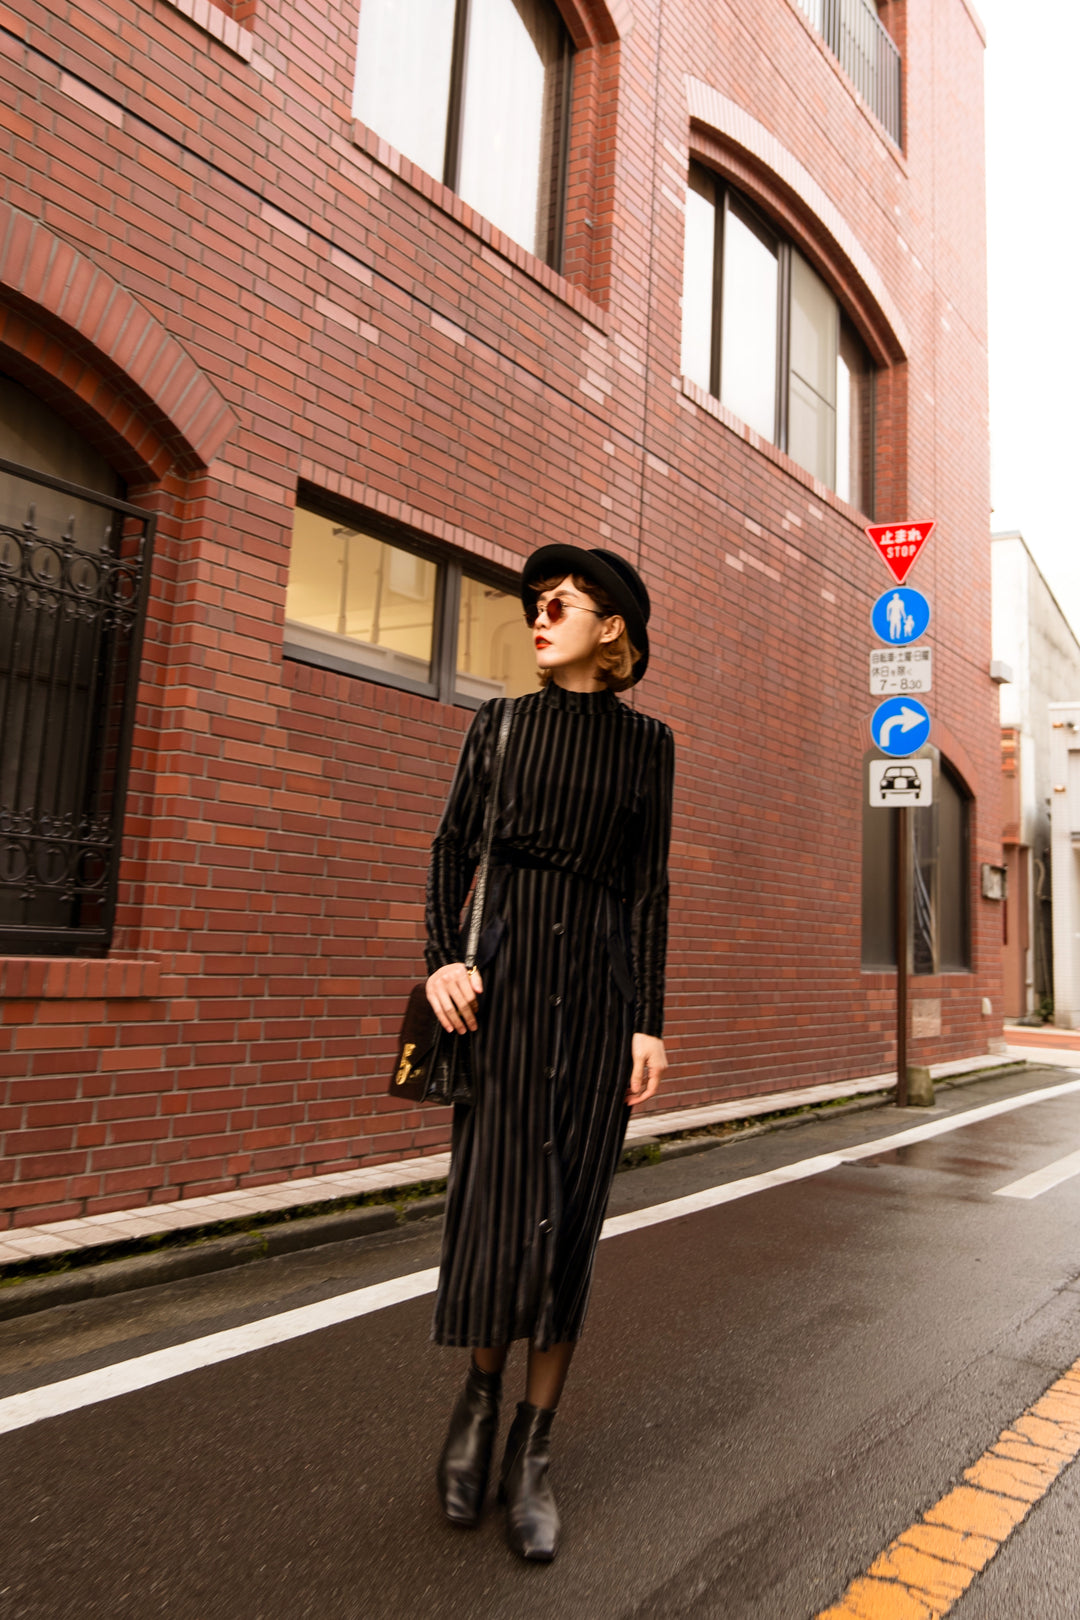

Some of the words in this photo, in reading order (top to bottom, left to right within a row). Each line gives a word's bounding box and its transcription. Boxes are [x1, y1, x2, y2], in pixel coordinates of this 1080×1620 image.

[879, 528, 922, 545] 止まれ
[886, 544, 917, 559] STOP
